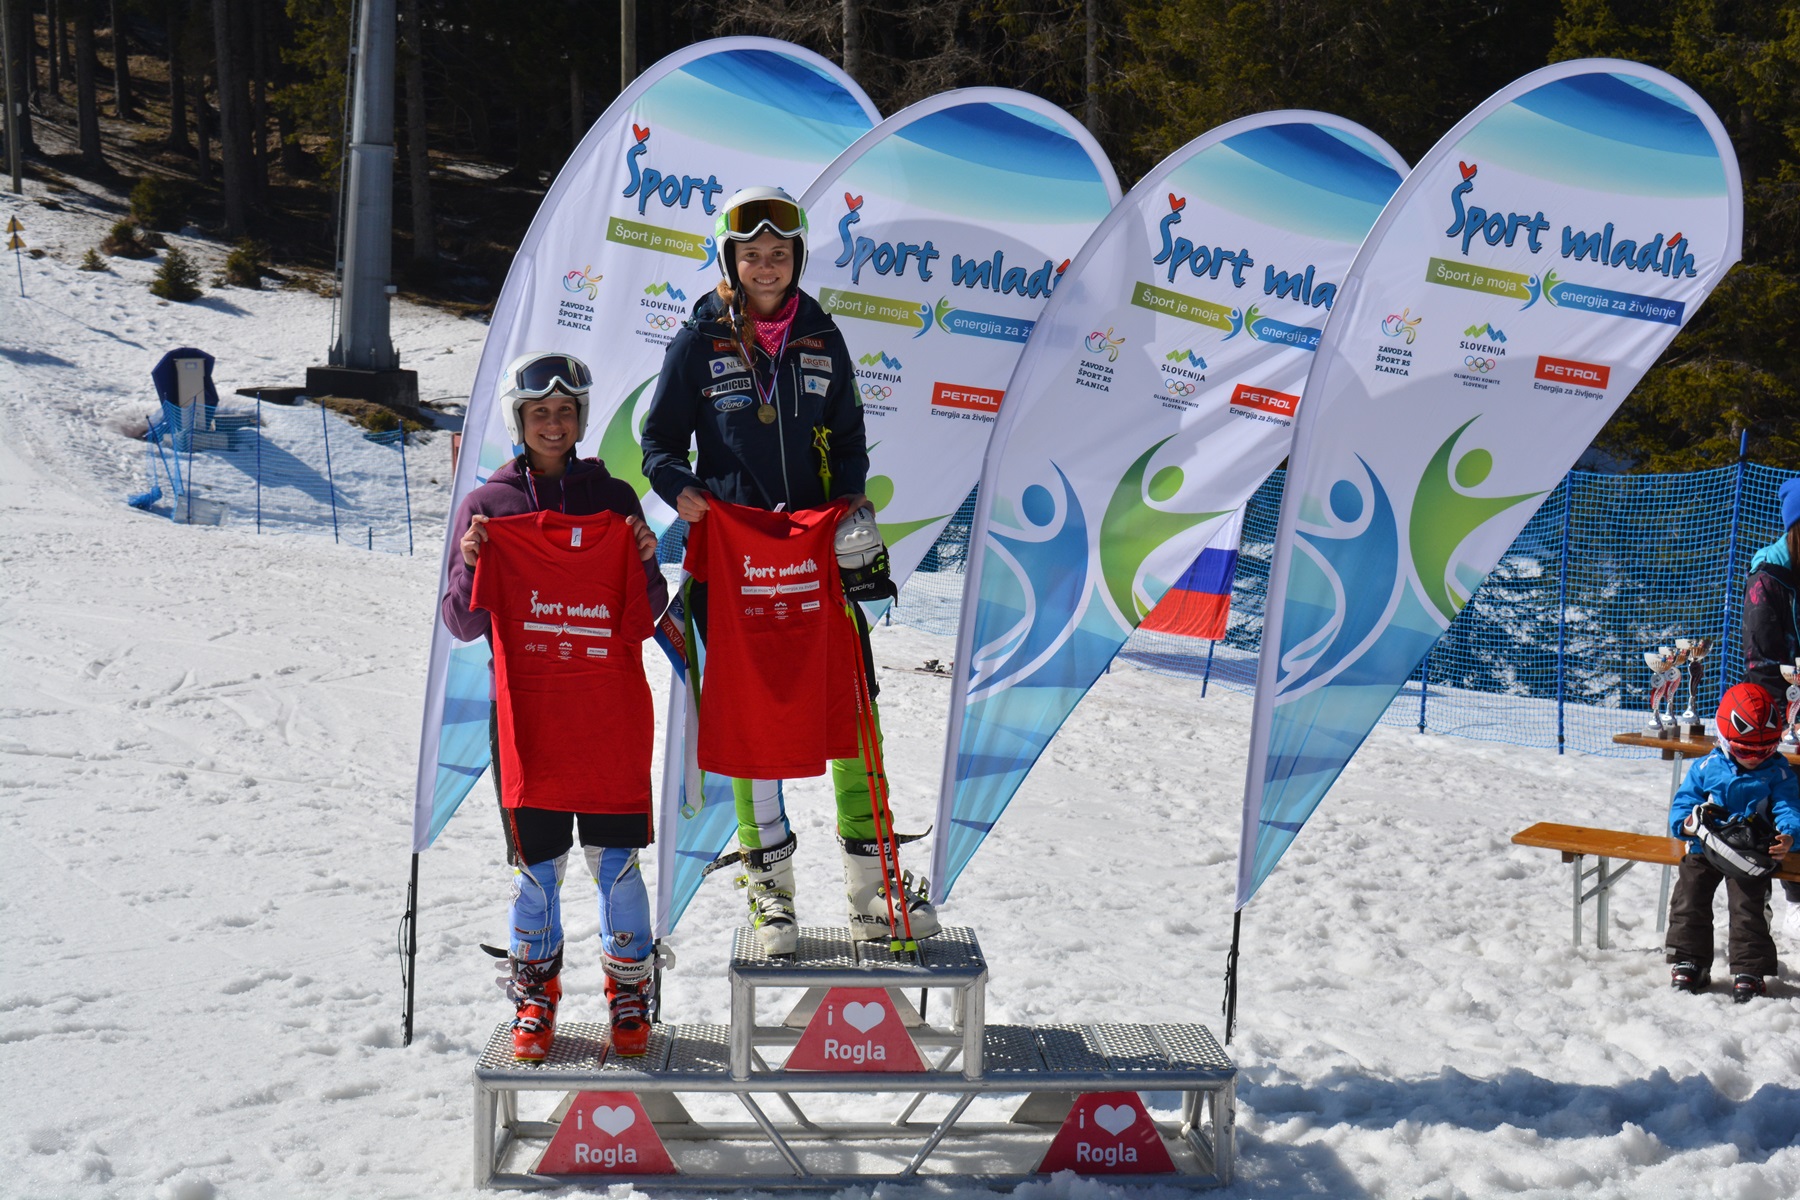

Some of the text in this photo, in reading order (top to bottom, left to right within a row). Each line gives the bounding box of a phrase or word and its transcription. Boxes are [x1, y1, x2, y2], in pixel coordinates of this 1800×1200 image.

[622, 123, 723, 216] Šport
[1446, 161, 1549, 255] Šport
[615, 223, 694, 252] Šport je moja
[835, 192, 939, 286] Šport
[1153, 192, 1337, 311] Šport mla
[1437, 264, 1517, 292] Šport je moja
[561, 300, 595, 313] ZAVOD ZA
[641, 299, 686, 314] SLOVENIJA
[828, 294, 909, 320] Šport je moja
[1142, 289, 1220, 322] Šport je moja
[1560, 289, 1676, 321] energija za življenje
[559, 308, 583, 320] ŠPORT
[557, 319, 591, 331] PLANICA
[954, 317, 1002, 333] energija
[1006, 326, 1019, 335] za
[1262, 326, 1320, 346] energija za
[1378, 345, 1402, 356] ZAVOD
[1460, 341, 1506, 356] SLOVENIJA
[802, 356, 830, 368] ARGETA
[1080, 360, 1104, 371] ZAVOD
[1376, 354, 1400, 365] ŠPORT
[855, 369, 902, 384] SLOVENIJA
[1078, 368, 1102, 380] ŠPORT
[1161, 364, 1206, 382] SLOVENIJA
[1375, 365, 1409, 376] PLANICA
[1544, 364, 1601, 381] PETROL
[716, 379, 750, 393] AMICUS
[1076, 378, 1109, 392] PLANICA
[1533, 382, 1563, 394] Energija
[1574, 388, 1603, 401] življenje
[721, 397, 744, 410] Ford
[941, 390, 998, 405] PETROL
[1240, 391, 1291, 409] PETROL
[863, 409, 886, 417] LOVENIJE
[931, 408, 960, 419] Energija
[1229, 407, 1258, 420] Energija
[849, 582, 876, 592] racing
[762, 841, 795, 863] BOOSTER
[607, 962, 644, 972] ATOMIC
[828, 1005, 833, 1026] i
[824, 1039, 886, 1064] Rogla
[577, 1109, 583, 1130] i
[1079, 1108, 1085, 1129] i
[575, 1143, 637, 1168] Rogla
[1077, 1142, 1138, 1167] Rogla
